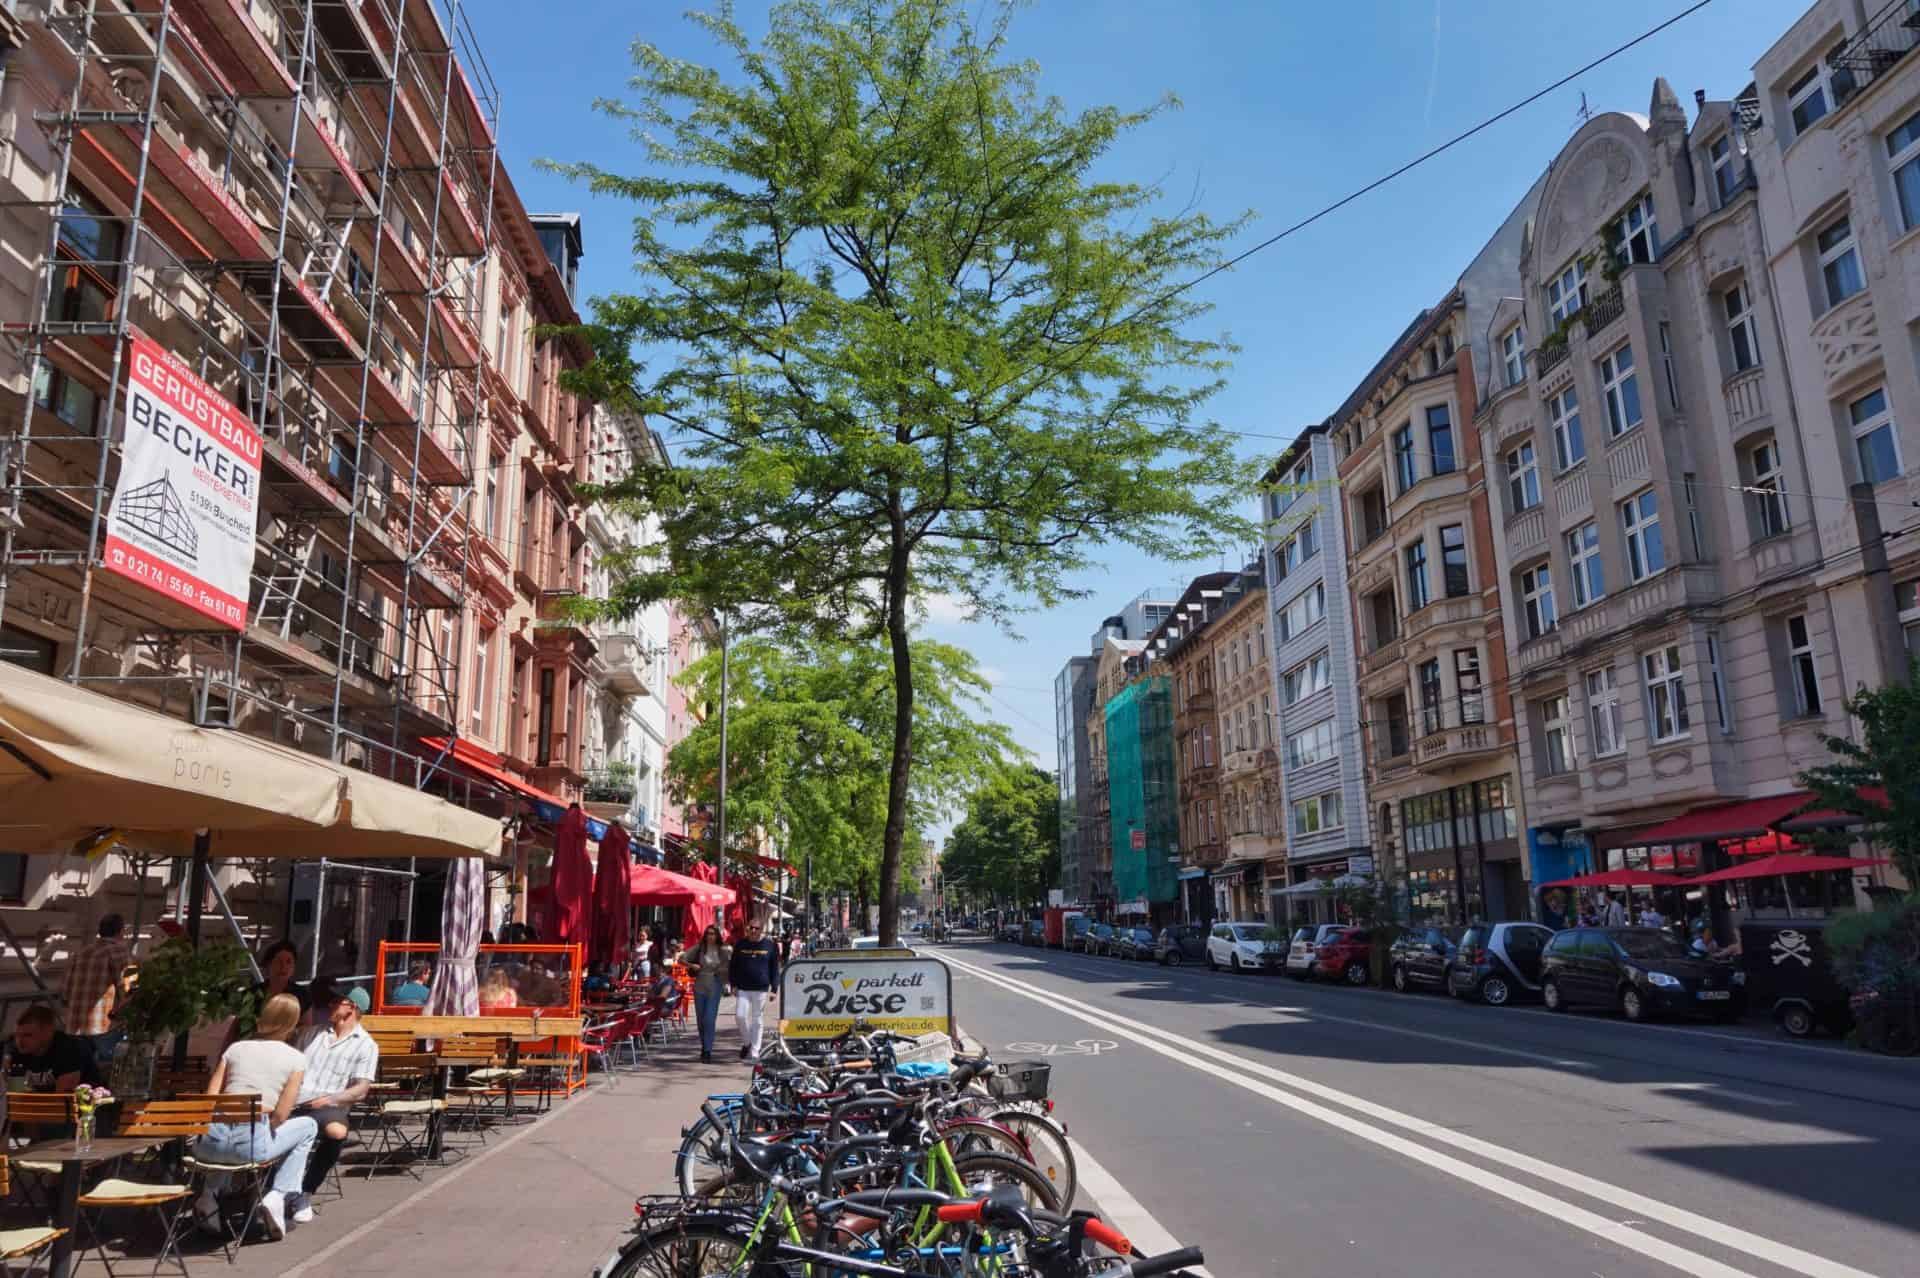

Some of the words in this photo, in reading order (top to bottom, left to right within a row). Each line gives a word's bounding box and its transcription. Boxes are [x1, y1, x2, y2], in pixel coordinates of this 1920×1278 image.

[132, 392, 249, 496] BECKER
[213, 504, 251, 536] Bucheid
[128, 556, 135, 571] 0
[136, 560, 148, 577] 21
[151, 566, 163, 585] 74
[169, 577, 181, 593] 55
[199, 591, 215, 610] Fax
[174, 758, 232, 788] paris
[811, 965, 844, 982] der
[856, 972, 926, 992] parkett
[803, 983, 907, 1016] Riese
